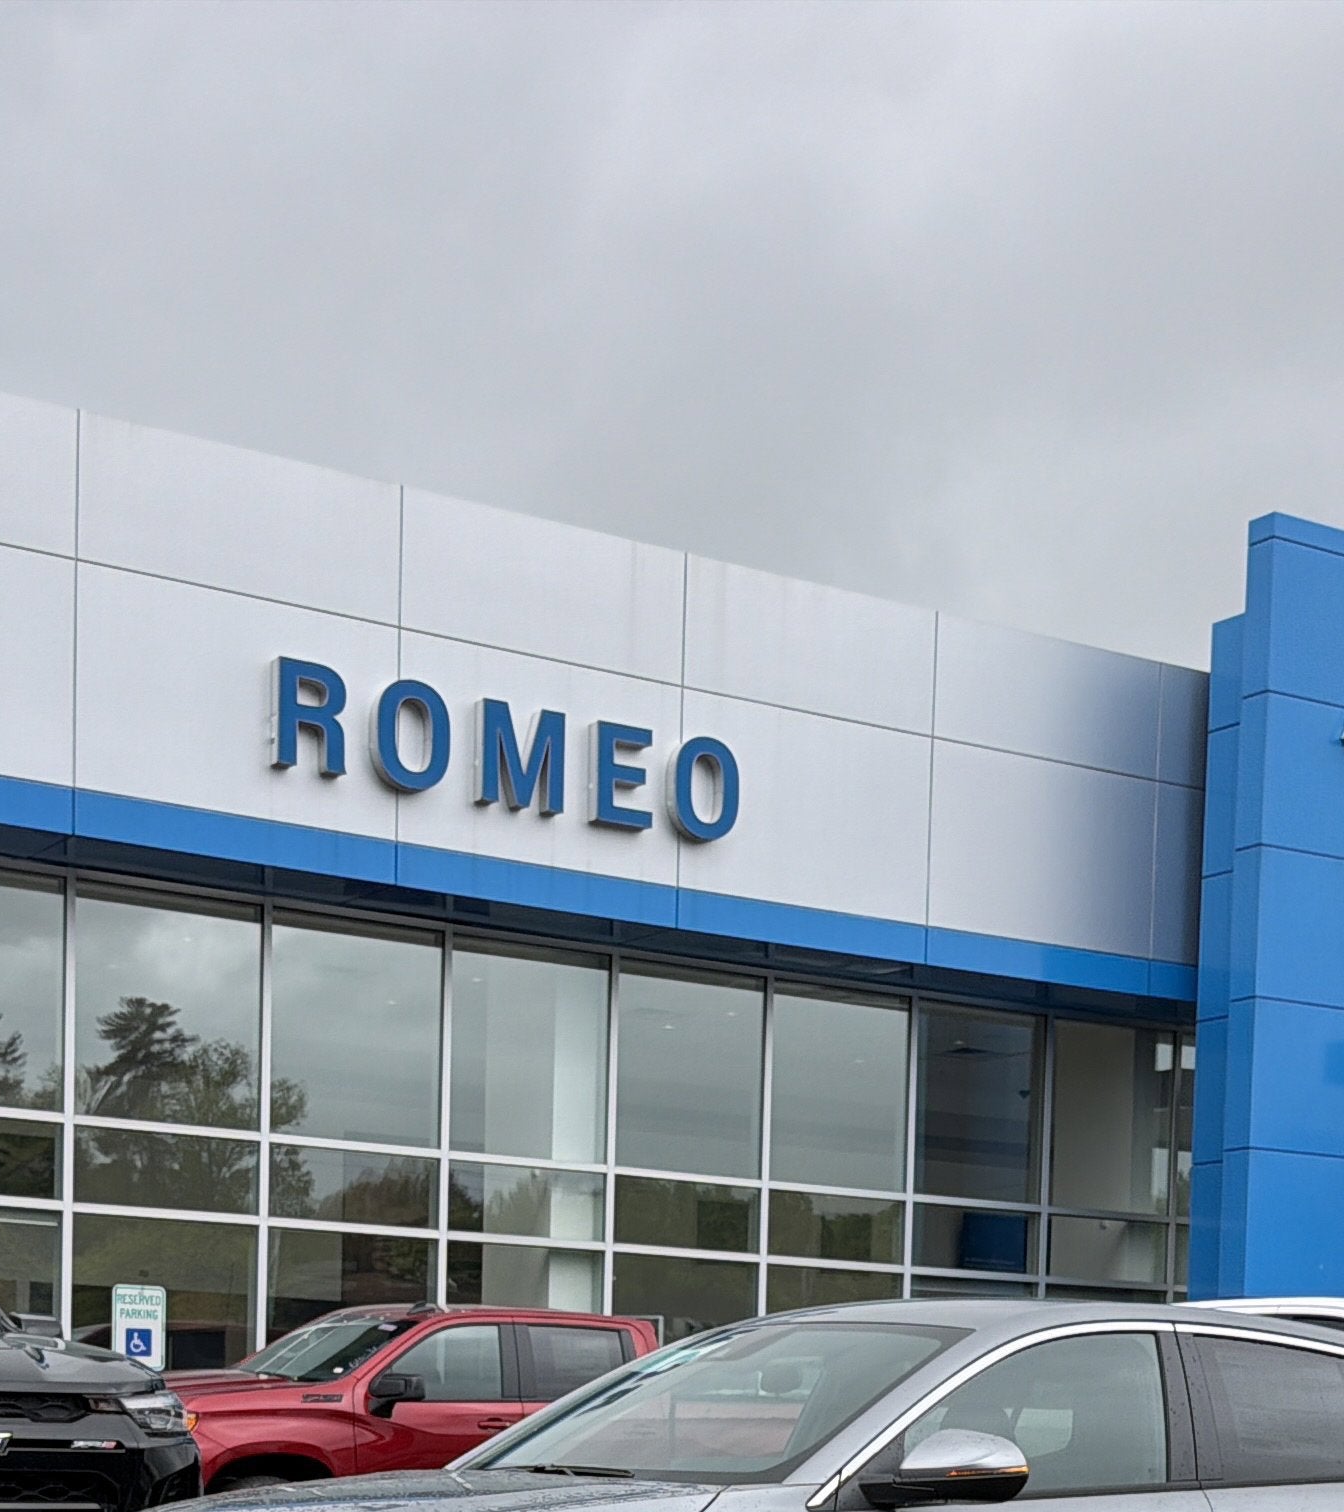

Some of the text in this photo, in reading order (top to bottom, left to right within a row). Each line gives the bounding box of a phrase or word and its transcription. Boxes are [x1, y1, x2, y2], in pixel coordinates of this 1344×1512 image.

[270, 656, 739, 843] ROMEO
[116, 1293, 161, 1306] RESERVED
[119, 1307, 158, 1320] PARKING
